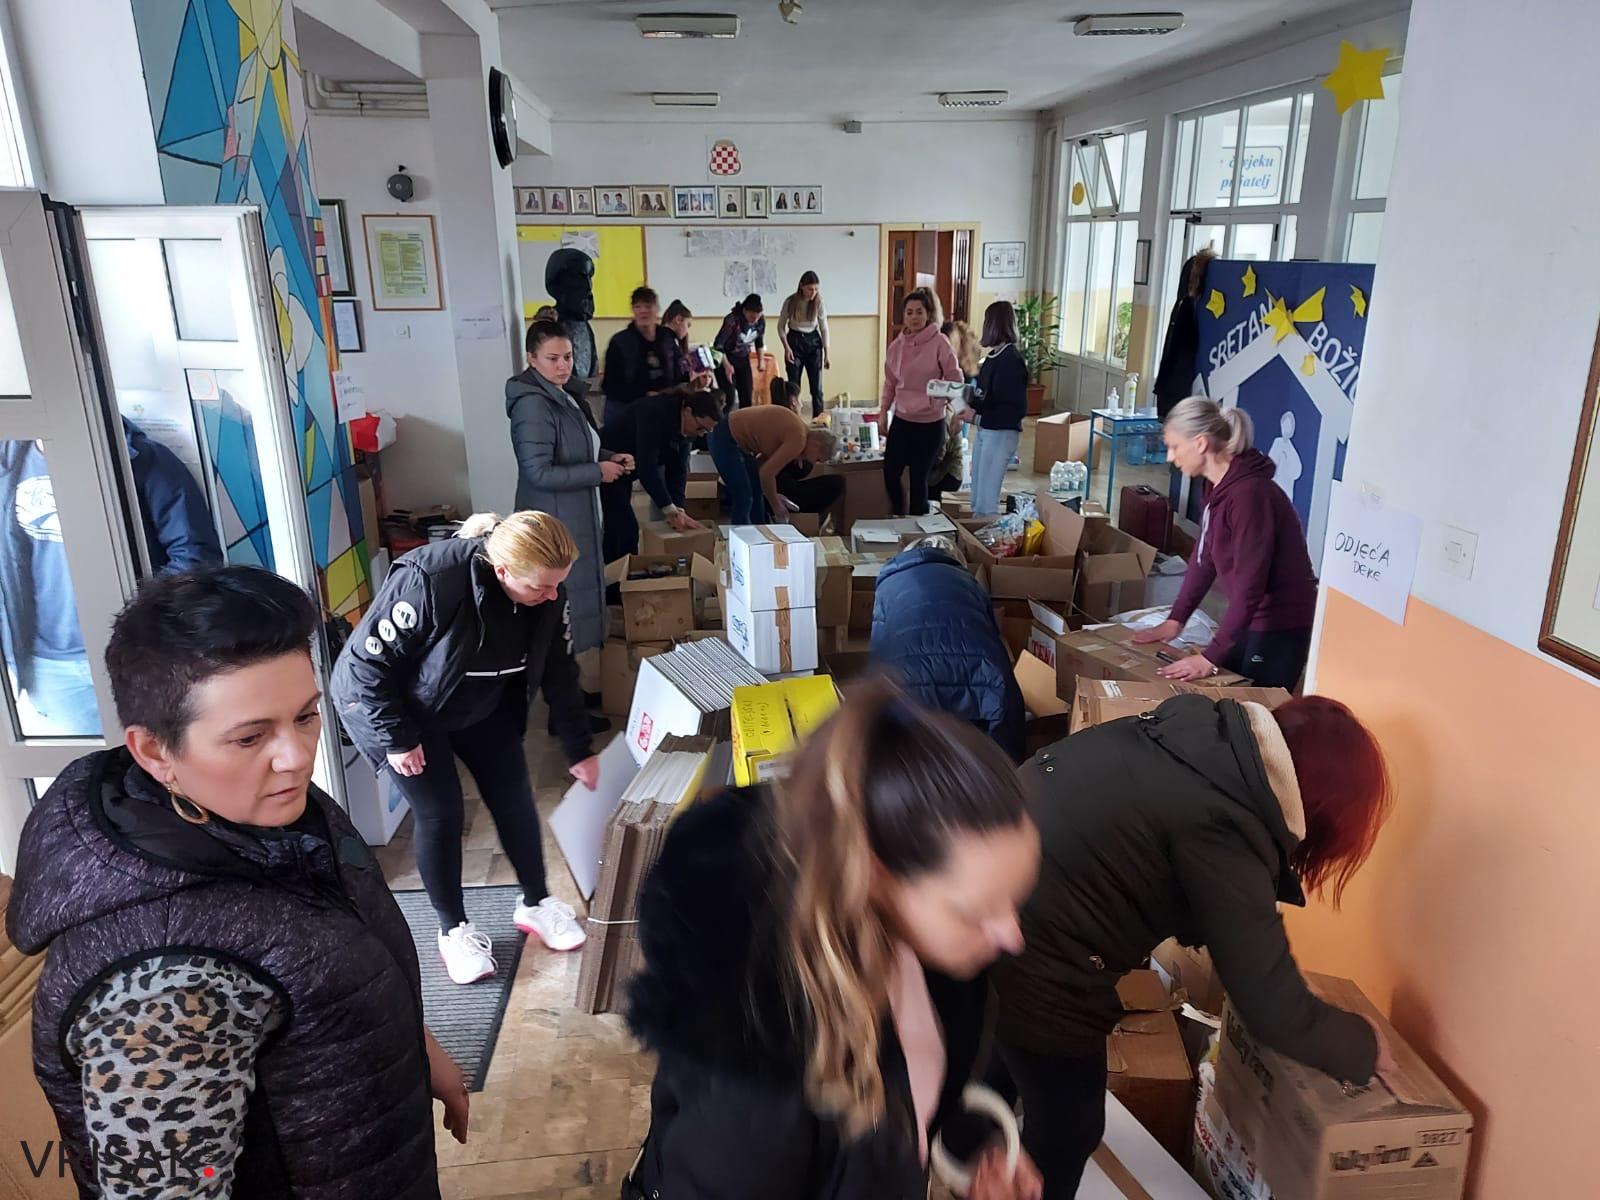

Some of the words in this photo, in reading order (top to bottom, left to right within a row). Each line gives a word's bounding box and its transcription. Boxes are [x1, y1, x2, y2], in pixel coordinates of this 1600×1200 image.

[1209, 296, 1273, 371] SRETAN
[1334, 531, 1390, 568] ODJEĆA
[1353, 560, 1381, 581] DEKE
